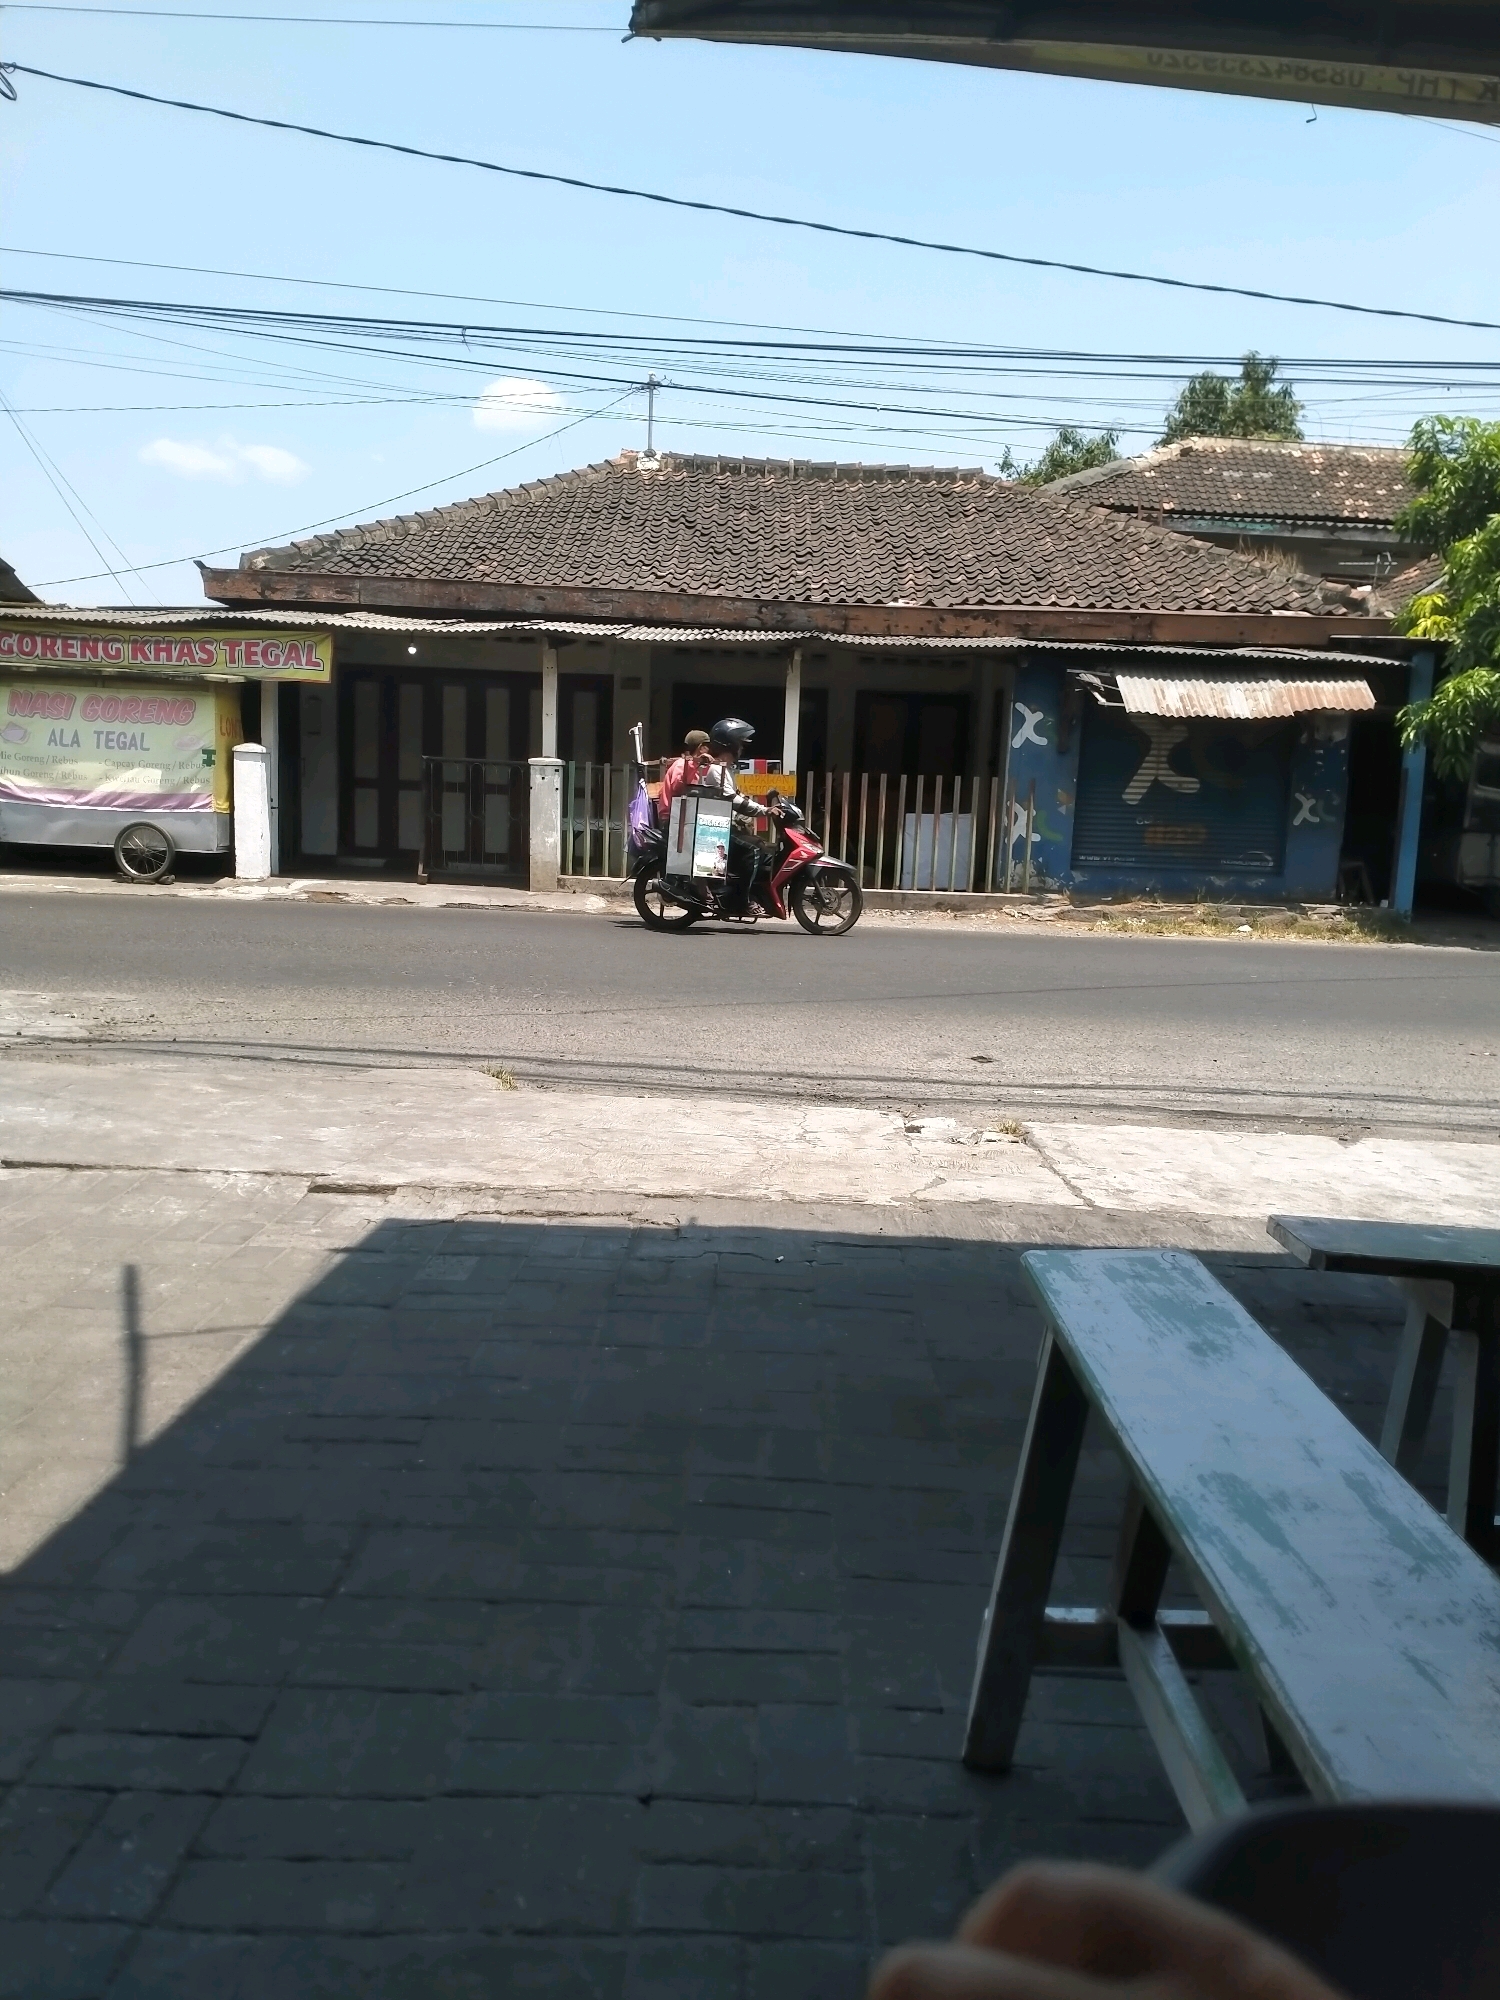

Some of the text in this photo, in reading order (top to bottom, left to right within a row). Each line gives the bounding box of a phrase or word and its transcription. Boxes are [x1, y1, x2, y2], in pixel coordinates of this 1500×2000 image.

[0, 632, 324, 671] GORENG KHAS TEGAL
[7, 689, 195, 725] NASI GORENG
[47, 728, 150, 751] ALA TEGAL
[14, 752, 44, 765] Goreng
[51, 755, 78, 765] Rebus
[104, 758, 135, 770] Capcay
[138, 760, 171, 771] Goreng
[178, 761, 206, 770] Rebus
[0, 766, 20, 776] ihun
[23, 768, 54, 782] Goreng
[61, 770, 88, 781] Rebus
[183, 776, 210, 785] Rebus
